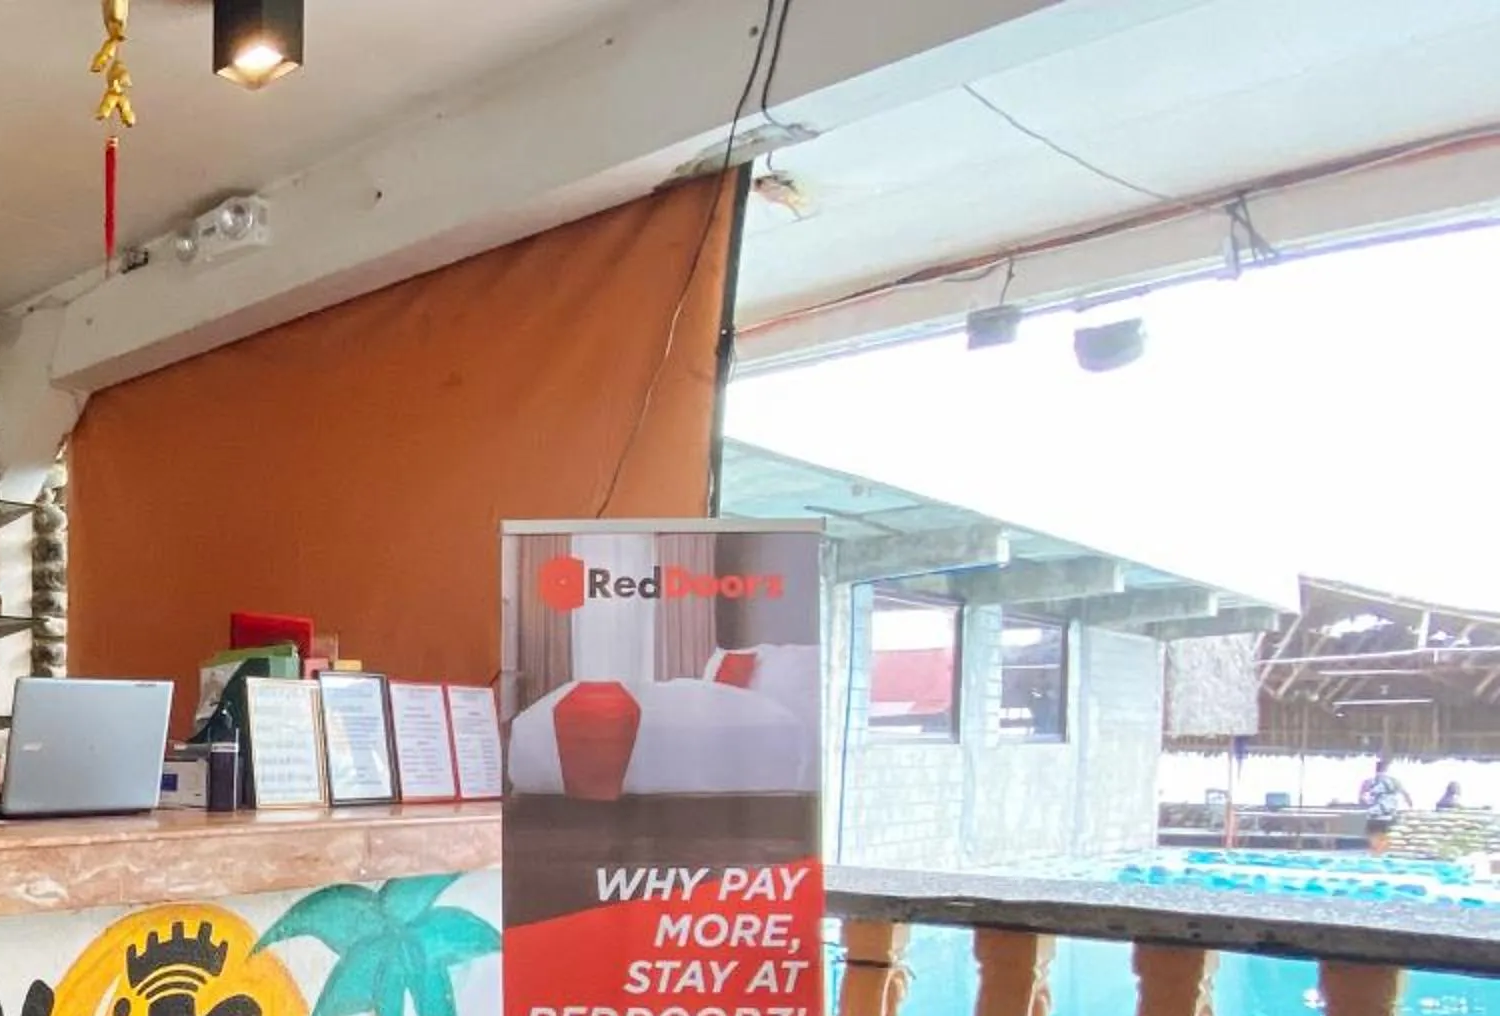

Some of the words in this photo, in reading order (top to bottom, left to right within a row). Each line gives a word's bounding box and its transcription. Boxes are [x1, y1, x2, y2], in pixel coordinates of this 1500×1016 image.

[596, 867, 709, 901] WHY
[718, 867, 809, 901] PAY
[653, 913, 801, 954] MORE,
[622, 960, 739, 994] STAY
[746, 960, 809, 994] AT
